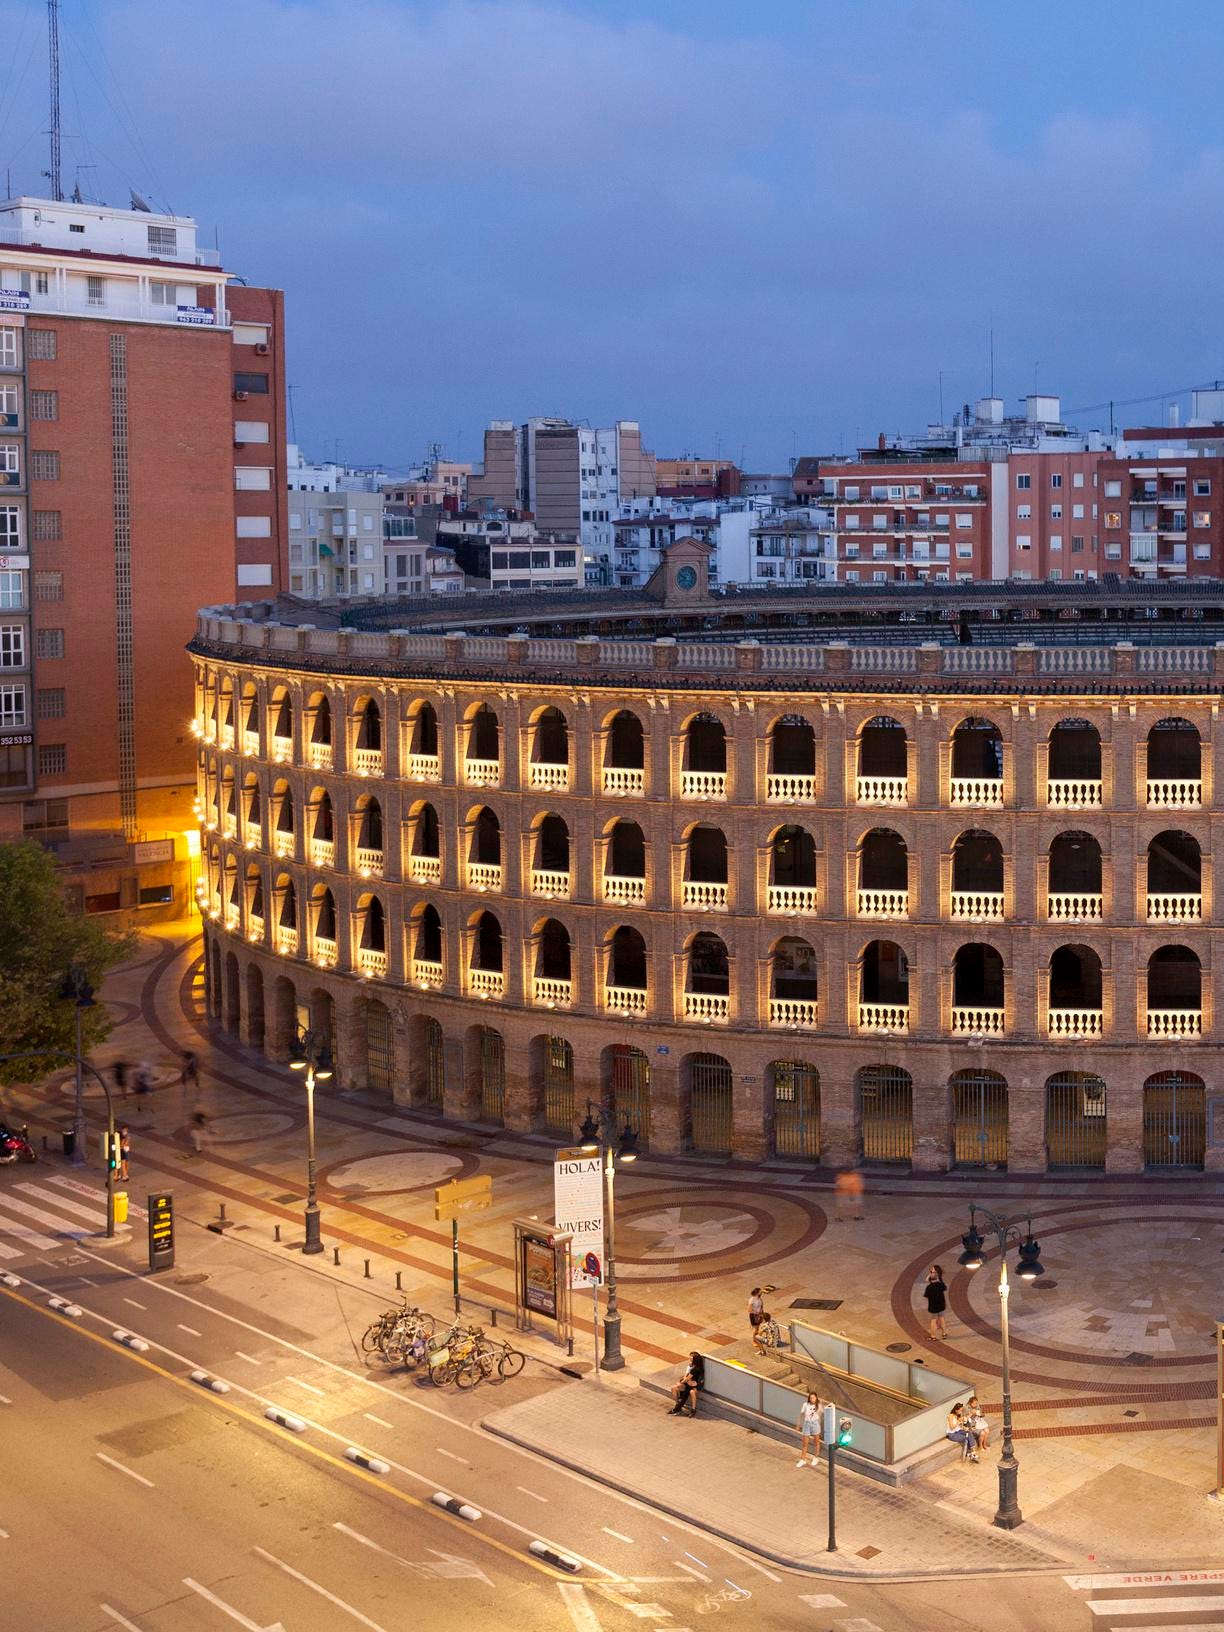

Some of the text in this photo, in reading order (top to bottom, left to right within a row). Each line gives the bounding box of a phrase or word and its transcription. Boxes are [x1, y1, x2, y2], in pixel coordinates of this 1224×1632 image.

[560, 1160, 600, 1175] HOLA!
[559, 1219, 601, 1232] VIVERS!
[1122, 1575, 1172, 1583] VERDE
